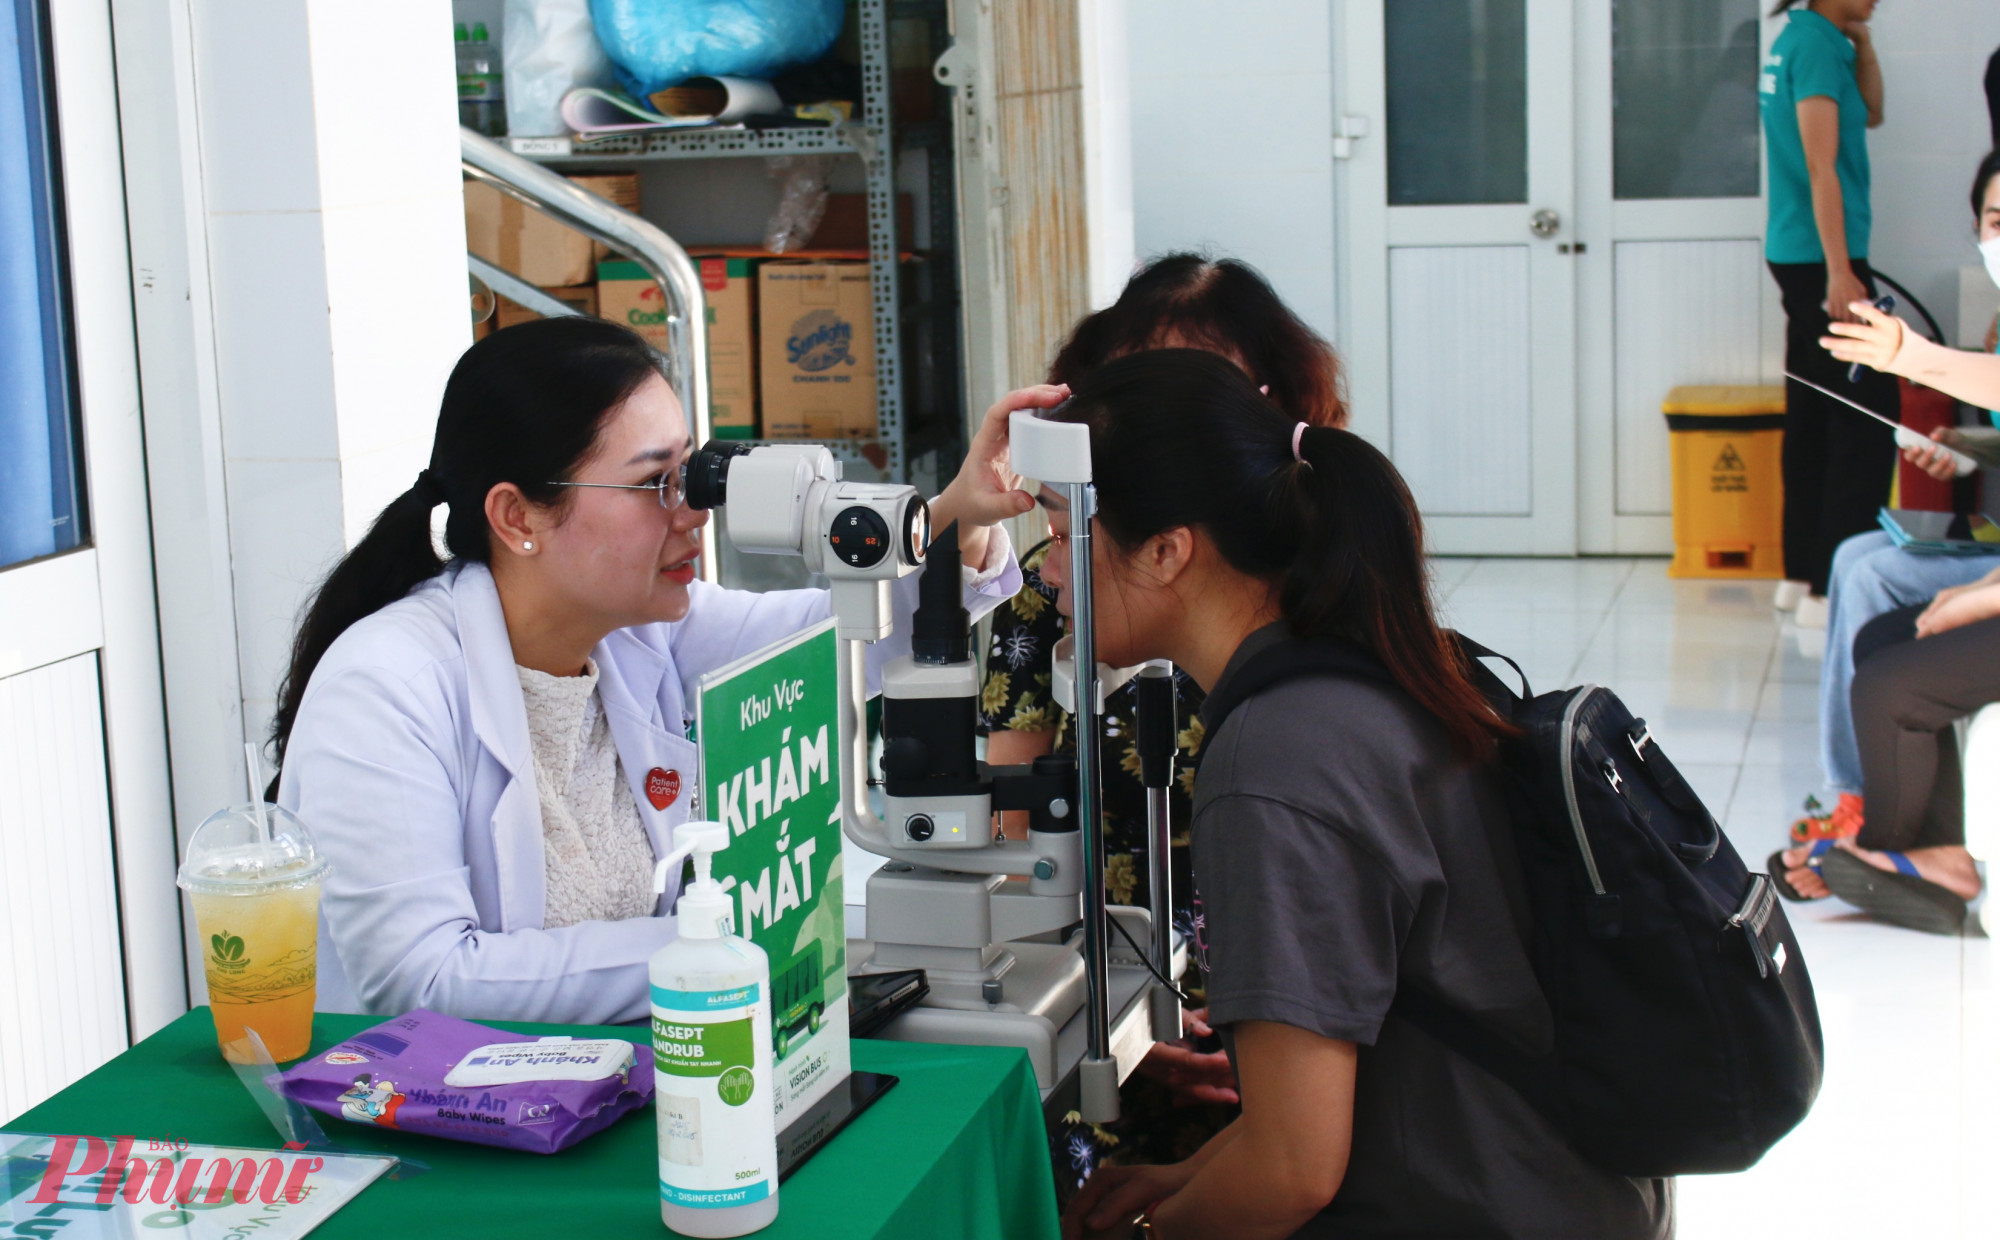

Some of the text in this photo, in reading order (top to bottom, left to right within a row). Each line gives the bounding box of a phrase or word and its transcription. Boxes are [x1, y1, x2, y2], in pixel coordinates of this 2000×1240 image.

[786, 321, 854, 363] Sunlight
[831, 536, 840, 544] 10
[740, 679, 805, 731] Khu Vực
[651, 776, 678, 788] Patient
[718, 724, 830, 837] KHÁM
[740, 818, 816, 940] MẮT
[707, 990, 749, 1003] ALFASEPT
[652, 1019, 704, 1041] LFASEPT
[498, 1051, 568, 1059] Baby Wipes
[653, 1037, 705, 1058] ANDRUB
[489, 1056, 523, 1067] An
[789, 1066, 811, 1089] VISION
[810, 1056, 822, 1074] BUS
[476, 1092, 508, 1113] An
[437, 1108, 466, 1122] Baby
[469, 1112, 506, 1126] Wipes
[735, 1168, 761, 1180] 500ml
[679, 1191, 747, 1203] DISINFECTANT
